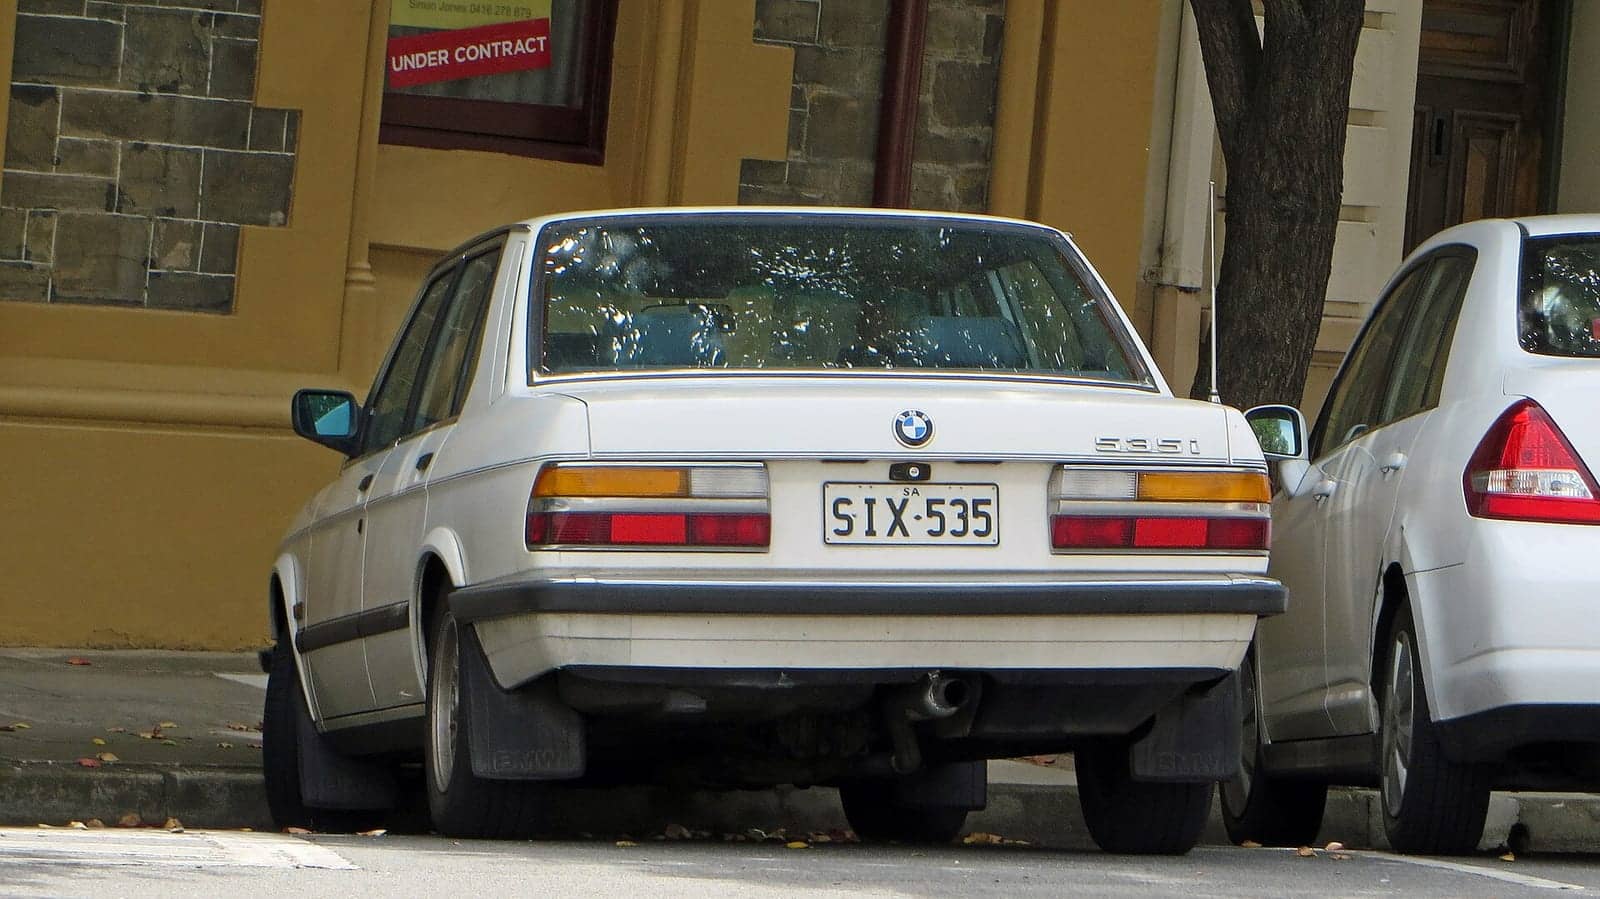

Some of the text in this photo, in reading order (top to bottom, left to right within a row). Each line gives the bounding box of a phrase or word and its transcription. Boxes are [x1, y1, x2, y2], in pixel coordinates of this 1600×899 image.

[391, 36, 548, 72] UNDER CONTRACT
[902, 487, 920, 497] SA
